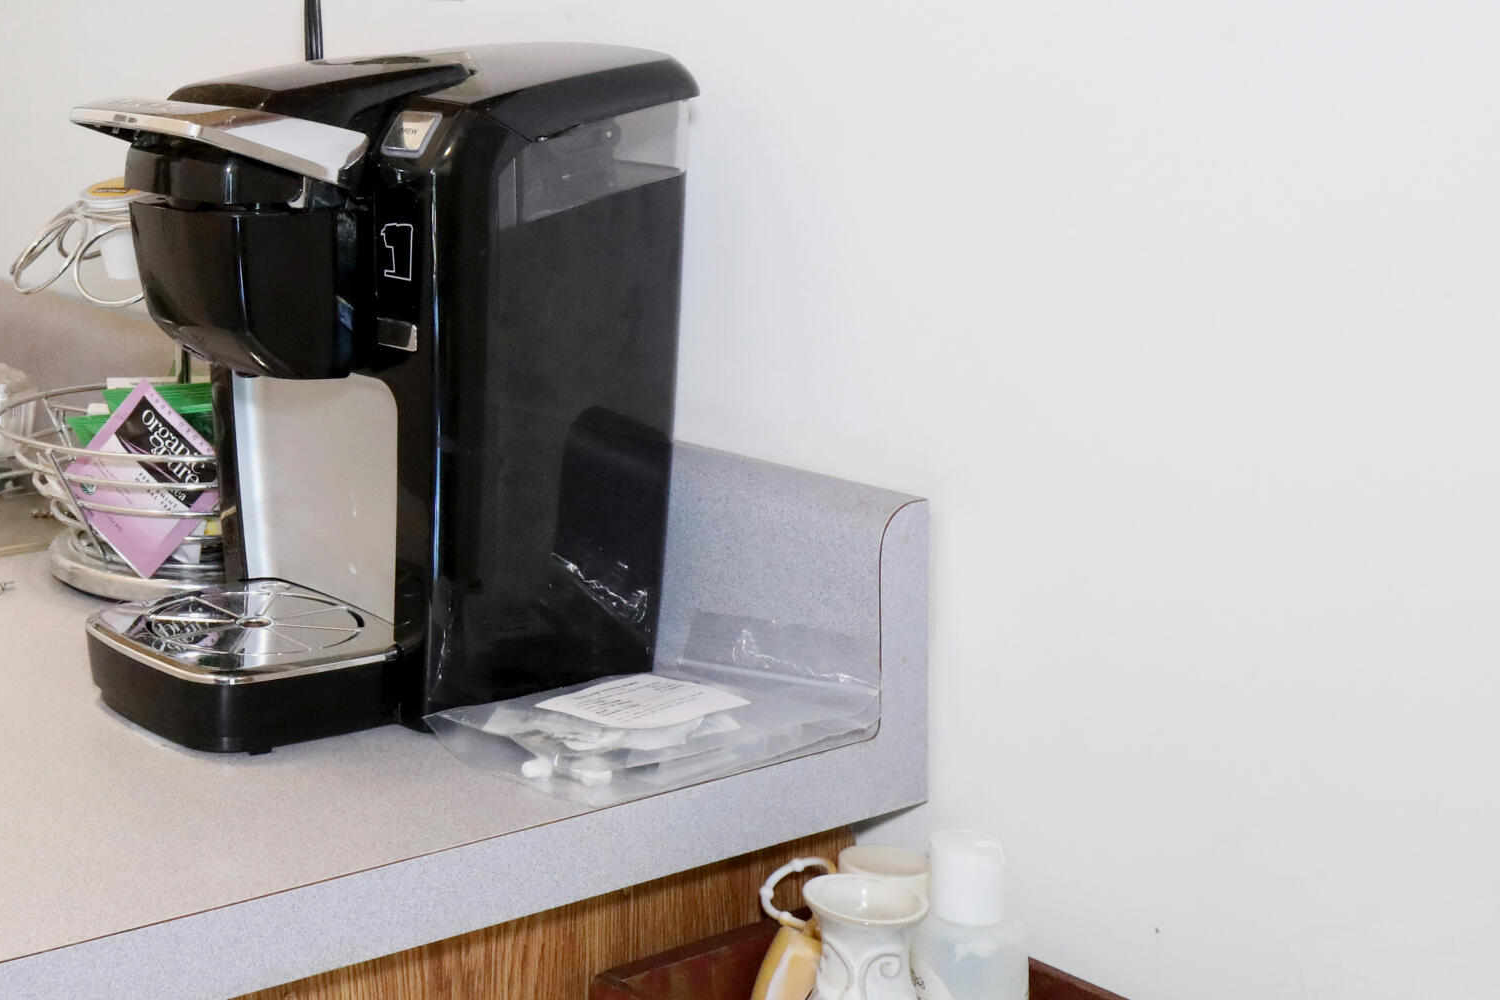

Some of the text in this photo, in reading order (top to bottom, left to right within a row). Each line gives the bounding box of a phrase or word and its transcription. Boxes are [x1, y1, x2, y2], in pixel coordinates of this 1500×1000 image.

[141, 409, 206, 475] organc
[138, 472, 178, 509] PEPRMINT
[170, 488, 187, 502] ea
